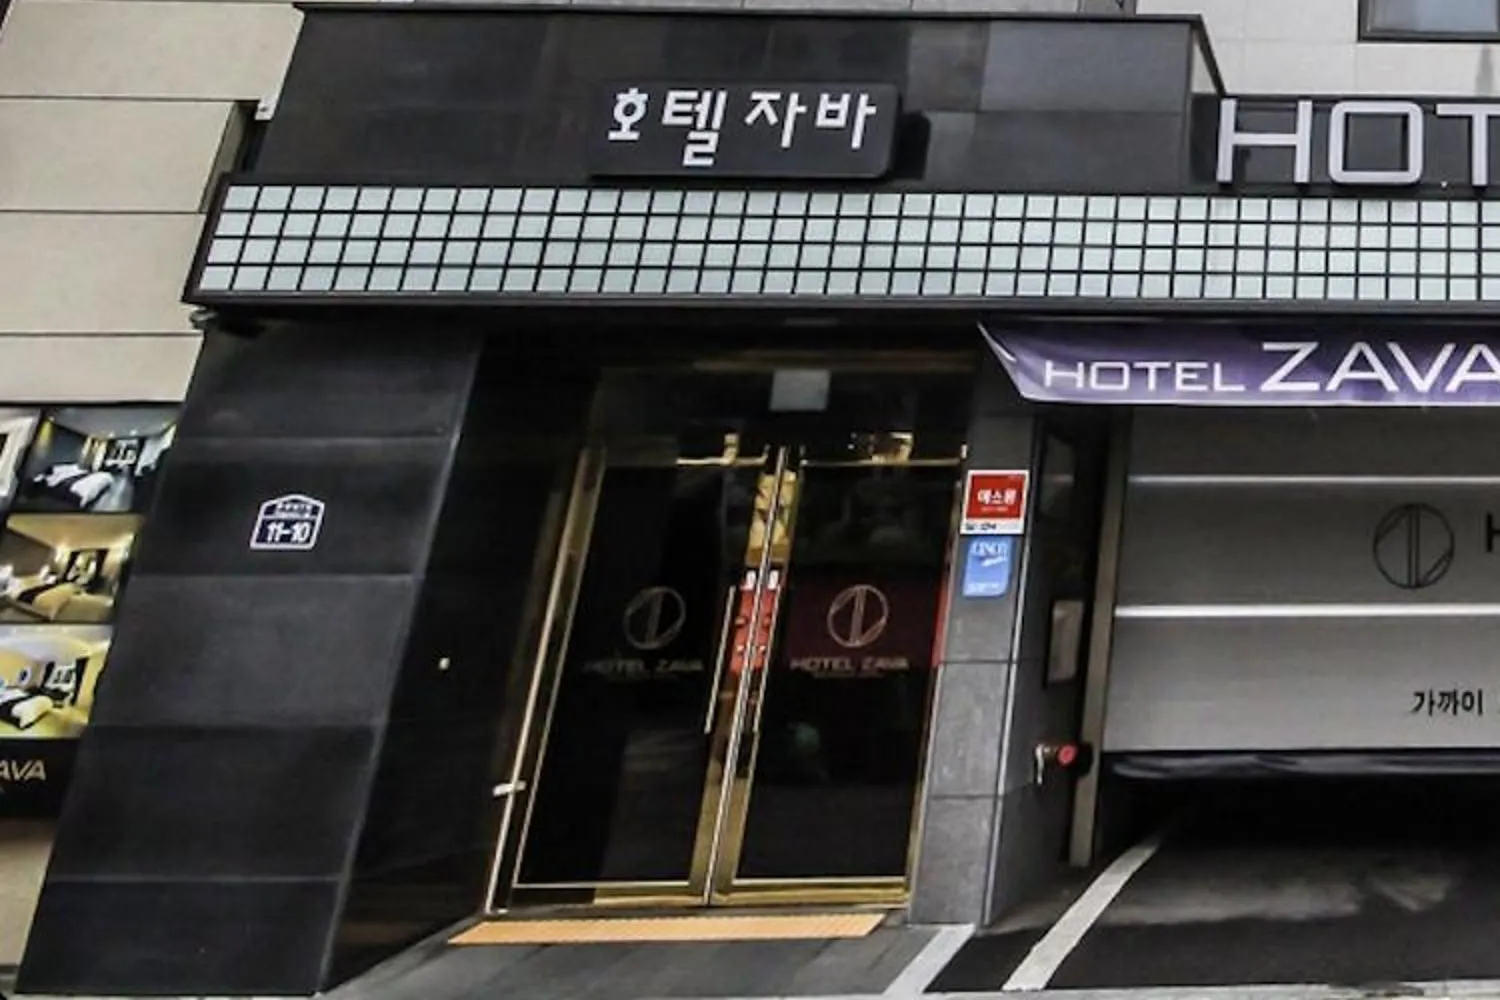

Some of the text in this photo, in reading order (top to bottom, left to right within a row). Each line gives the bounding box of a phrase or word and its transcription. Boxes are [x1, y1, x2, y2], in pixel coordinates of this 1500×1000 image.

[1042, 360, 1246, 393] HOTEL
[266, 521, 312, 543] 11-10
[1409, 689, 1484, 716] 가까이
